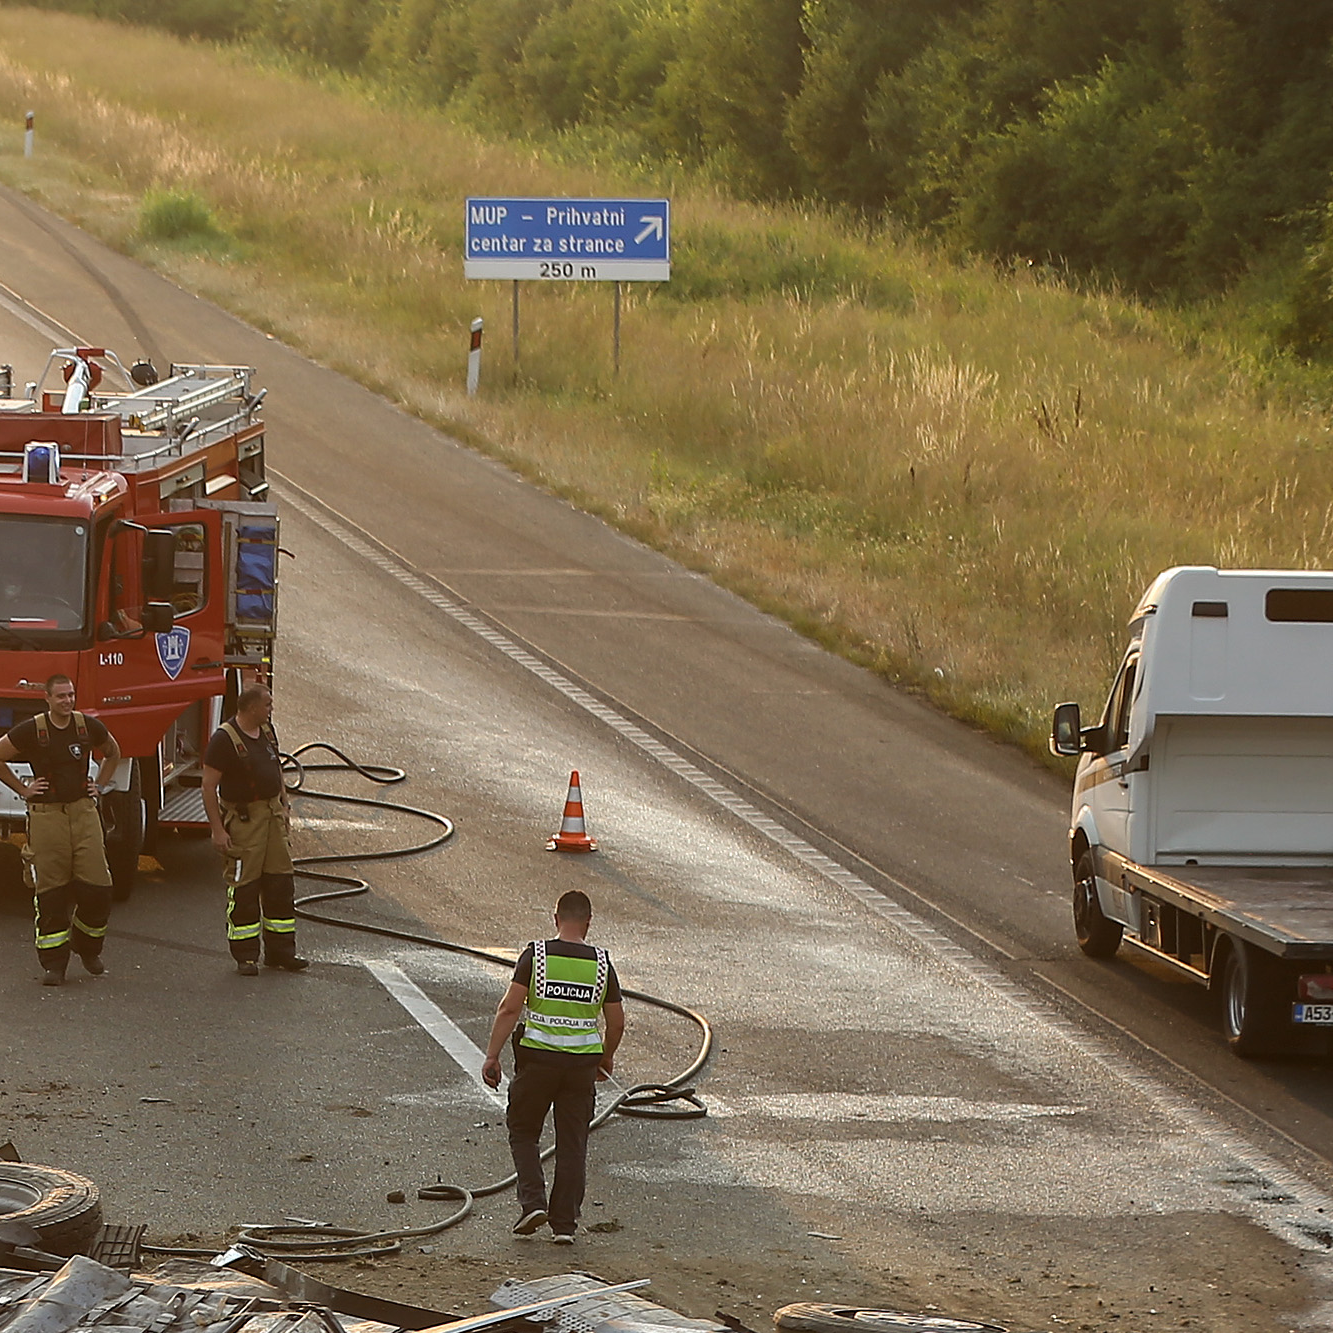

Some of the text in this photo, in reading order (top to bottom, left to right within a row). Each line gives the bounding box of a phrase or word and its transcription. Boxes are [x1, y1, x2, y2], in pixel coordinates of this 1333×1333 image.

[471, 206, 508, 225] MUP
[546, 206, 626, 226] Prihvatni
[471, 234, 625, 253] centar za strance
[539, 263, 596, 278] 250 m
[99, 652, 124, 666] L-110
[546, 985, 591, 999] POLICIJA
[549, 1017, 579, 1027] POLICIJA
